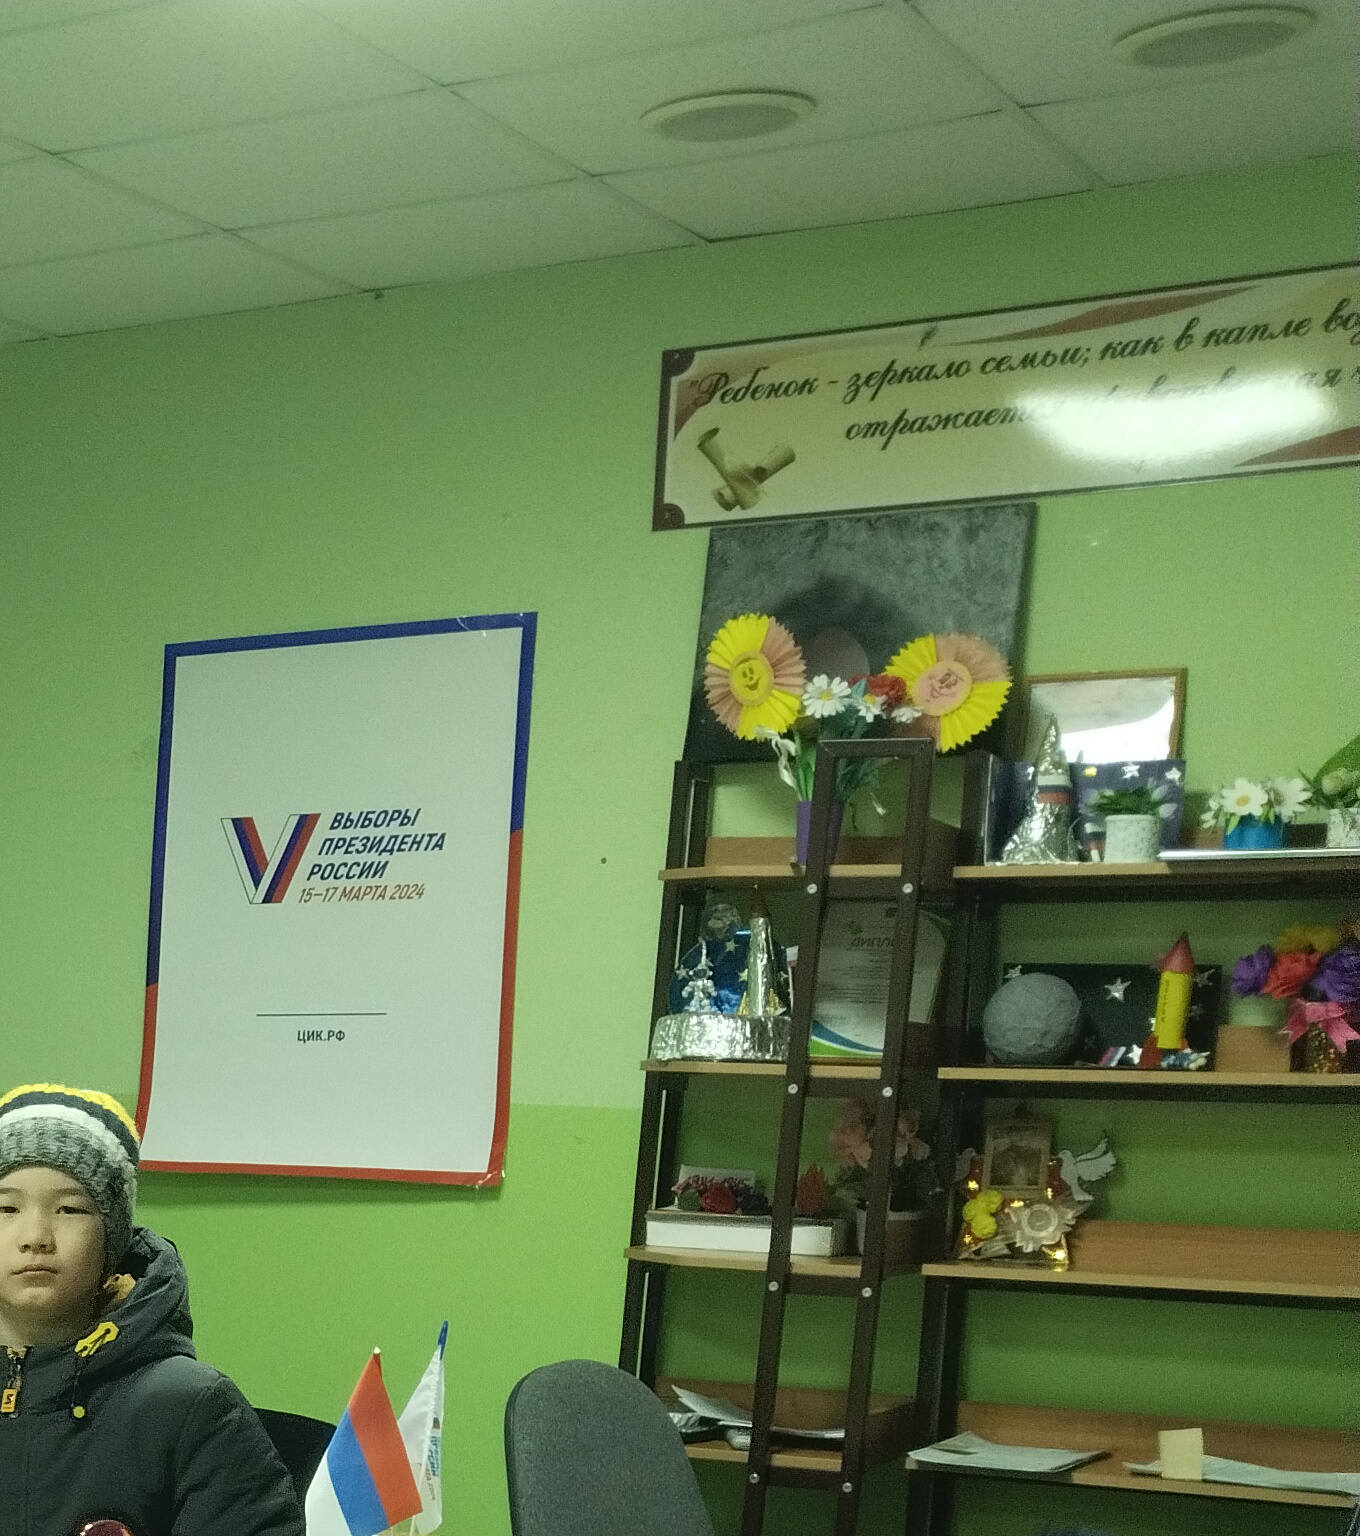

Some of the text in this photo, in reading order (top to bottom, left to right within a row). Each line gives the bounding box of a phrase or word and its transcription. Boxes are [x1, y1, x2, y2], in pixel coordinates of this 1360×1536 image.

[843, 359, 972, 405] зеркало
[1098, 333, 1166, 362] как
[1174, 316, 1200, 352] в
[1202, 317, 1313, 349] капле
[329, 808, 421, 830] ВЫБОРЫ
[318, 833, 446, 856] ПРЕЗИДЕНТА
[306, 861, 390, 881] РОССИИ
[338, 885, 388, 902] МАРТА
[389, 884, 425, 900] 2024
[296, 1029, 346, 1044] ЦИК.РФ
